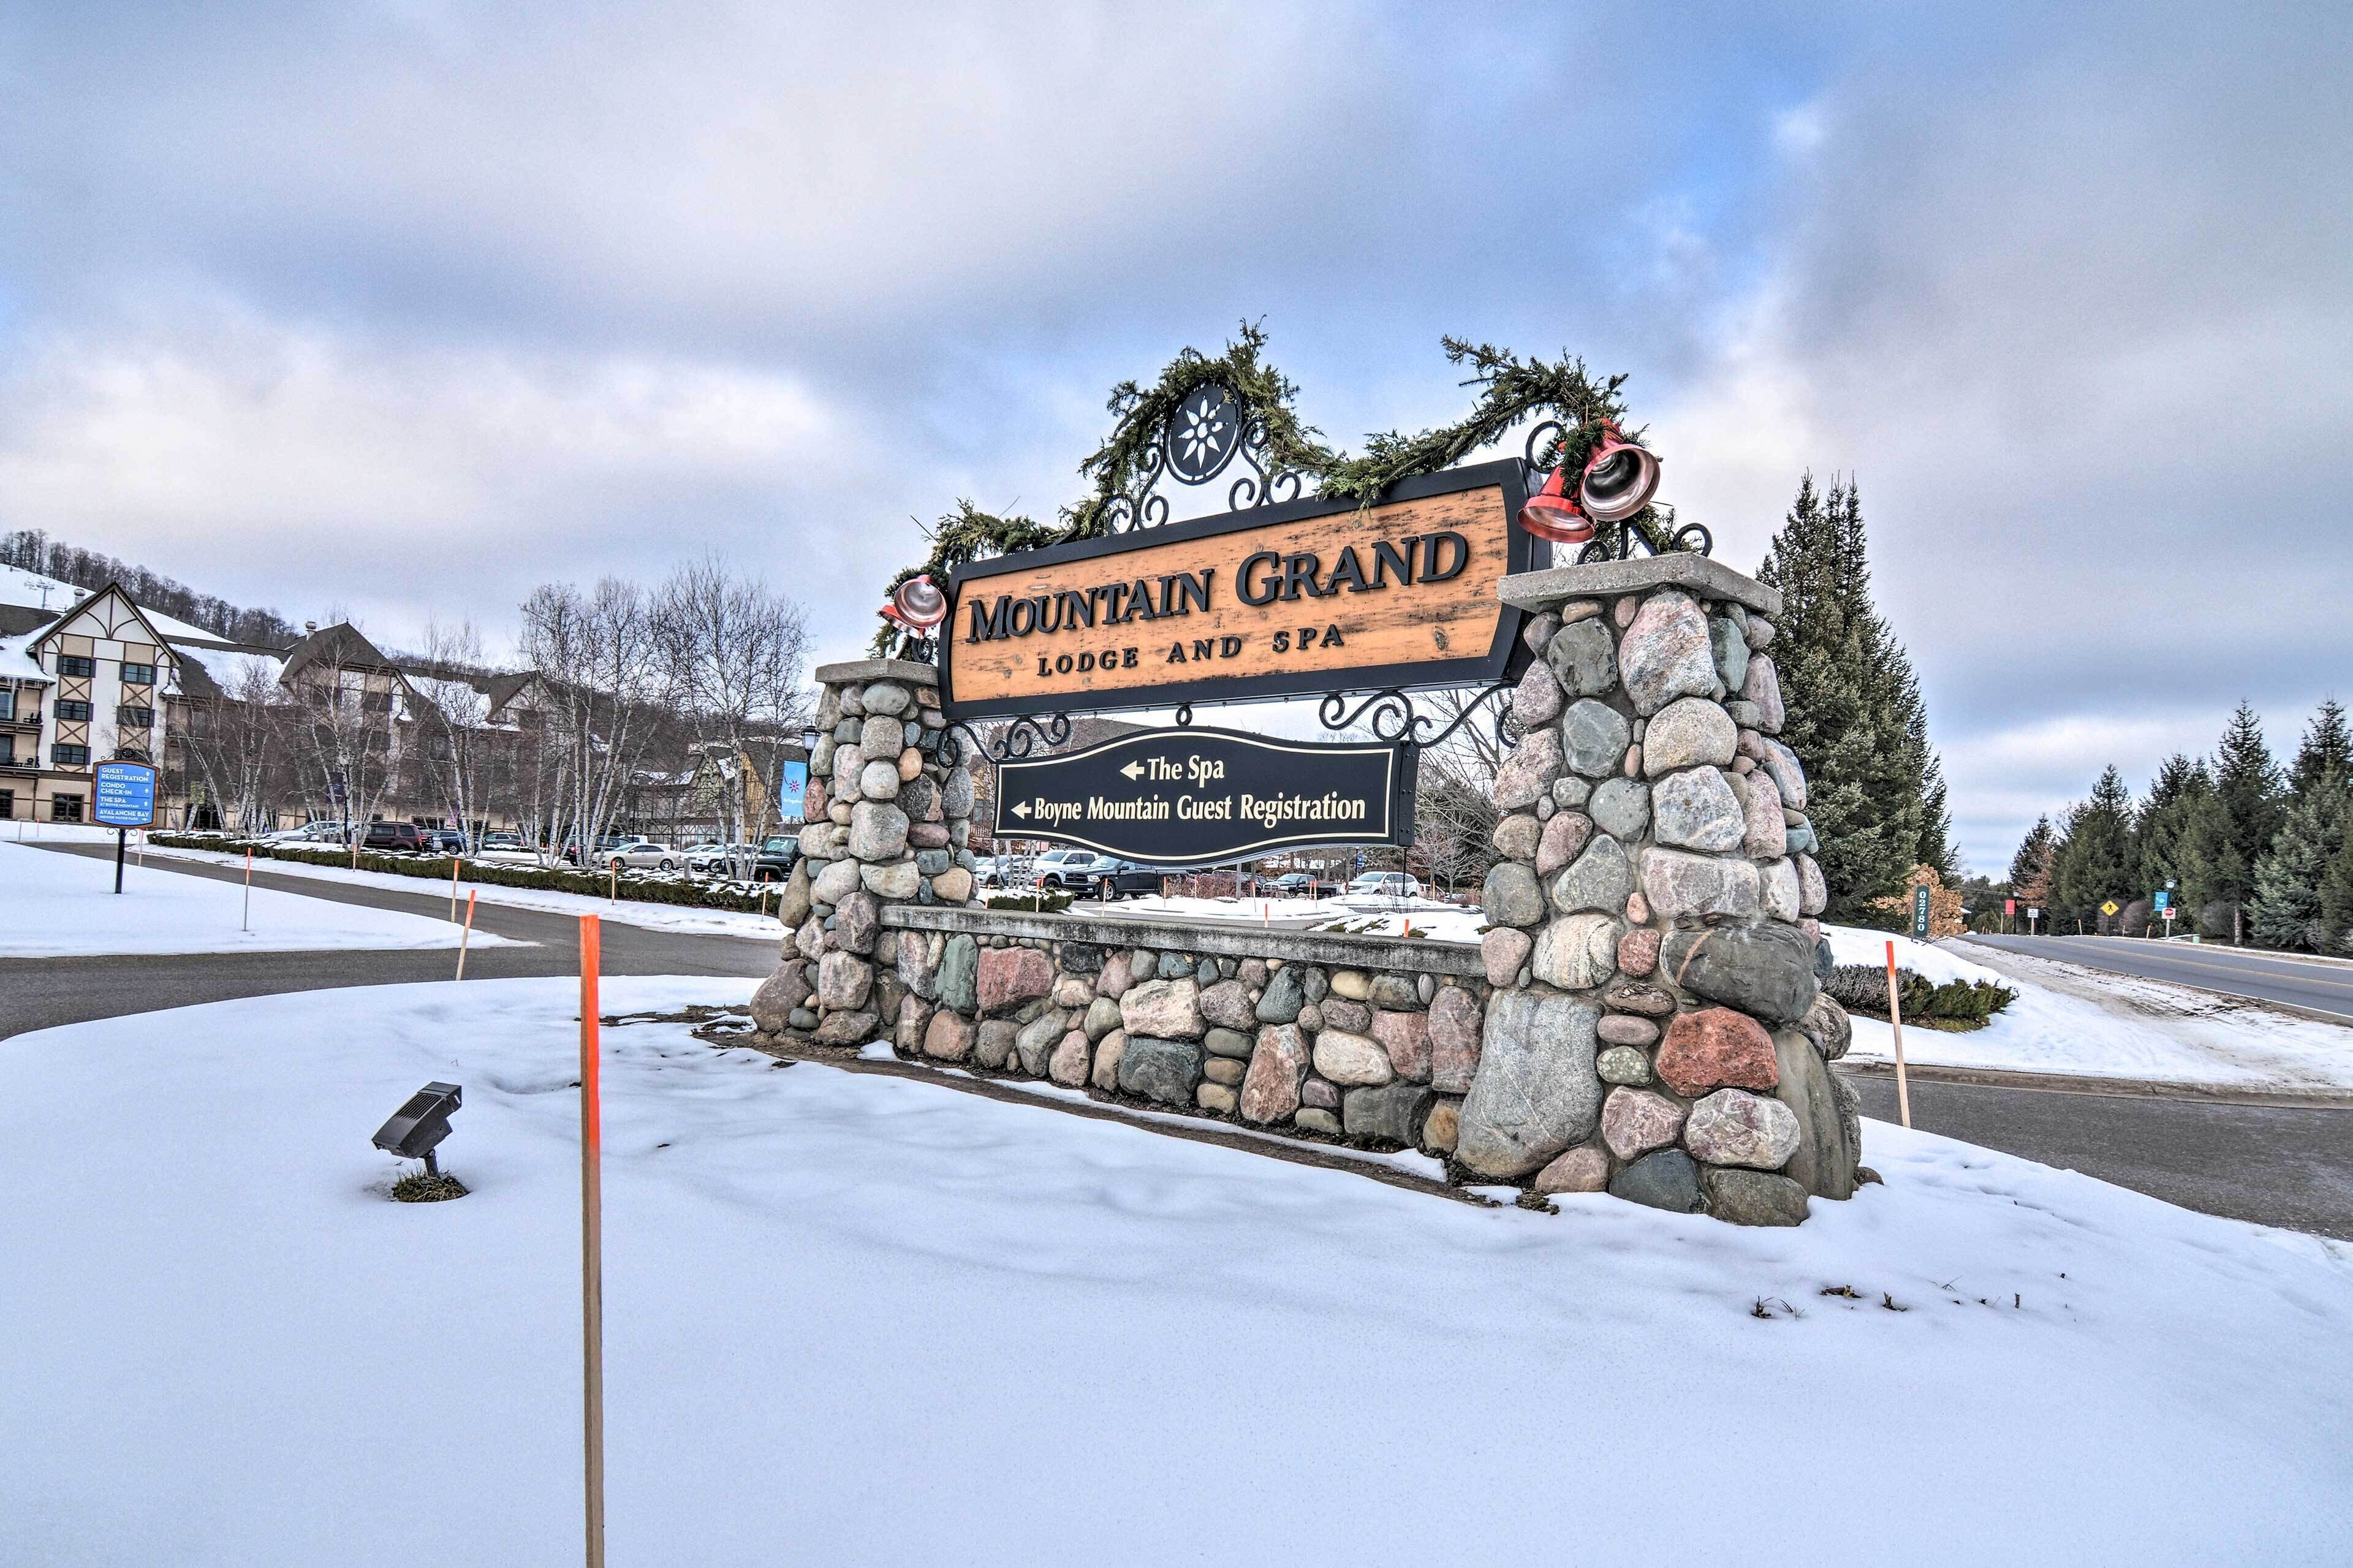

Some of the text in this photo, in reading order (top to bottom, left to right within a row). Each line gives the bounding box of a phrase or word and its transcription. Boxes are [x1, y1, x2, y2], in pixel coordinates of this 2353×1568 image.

[966, 531, 1469, 644] MOUNTAIN GRAND
[1037, 624, 1344, 676] LODGE AND SPA
[1147, 755, 1225, 788] The Spa
[1034, 792, 1366, 828] Boyne Mountain Guest Registration
[1917, 891, 1927, 931] 02780
